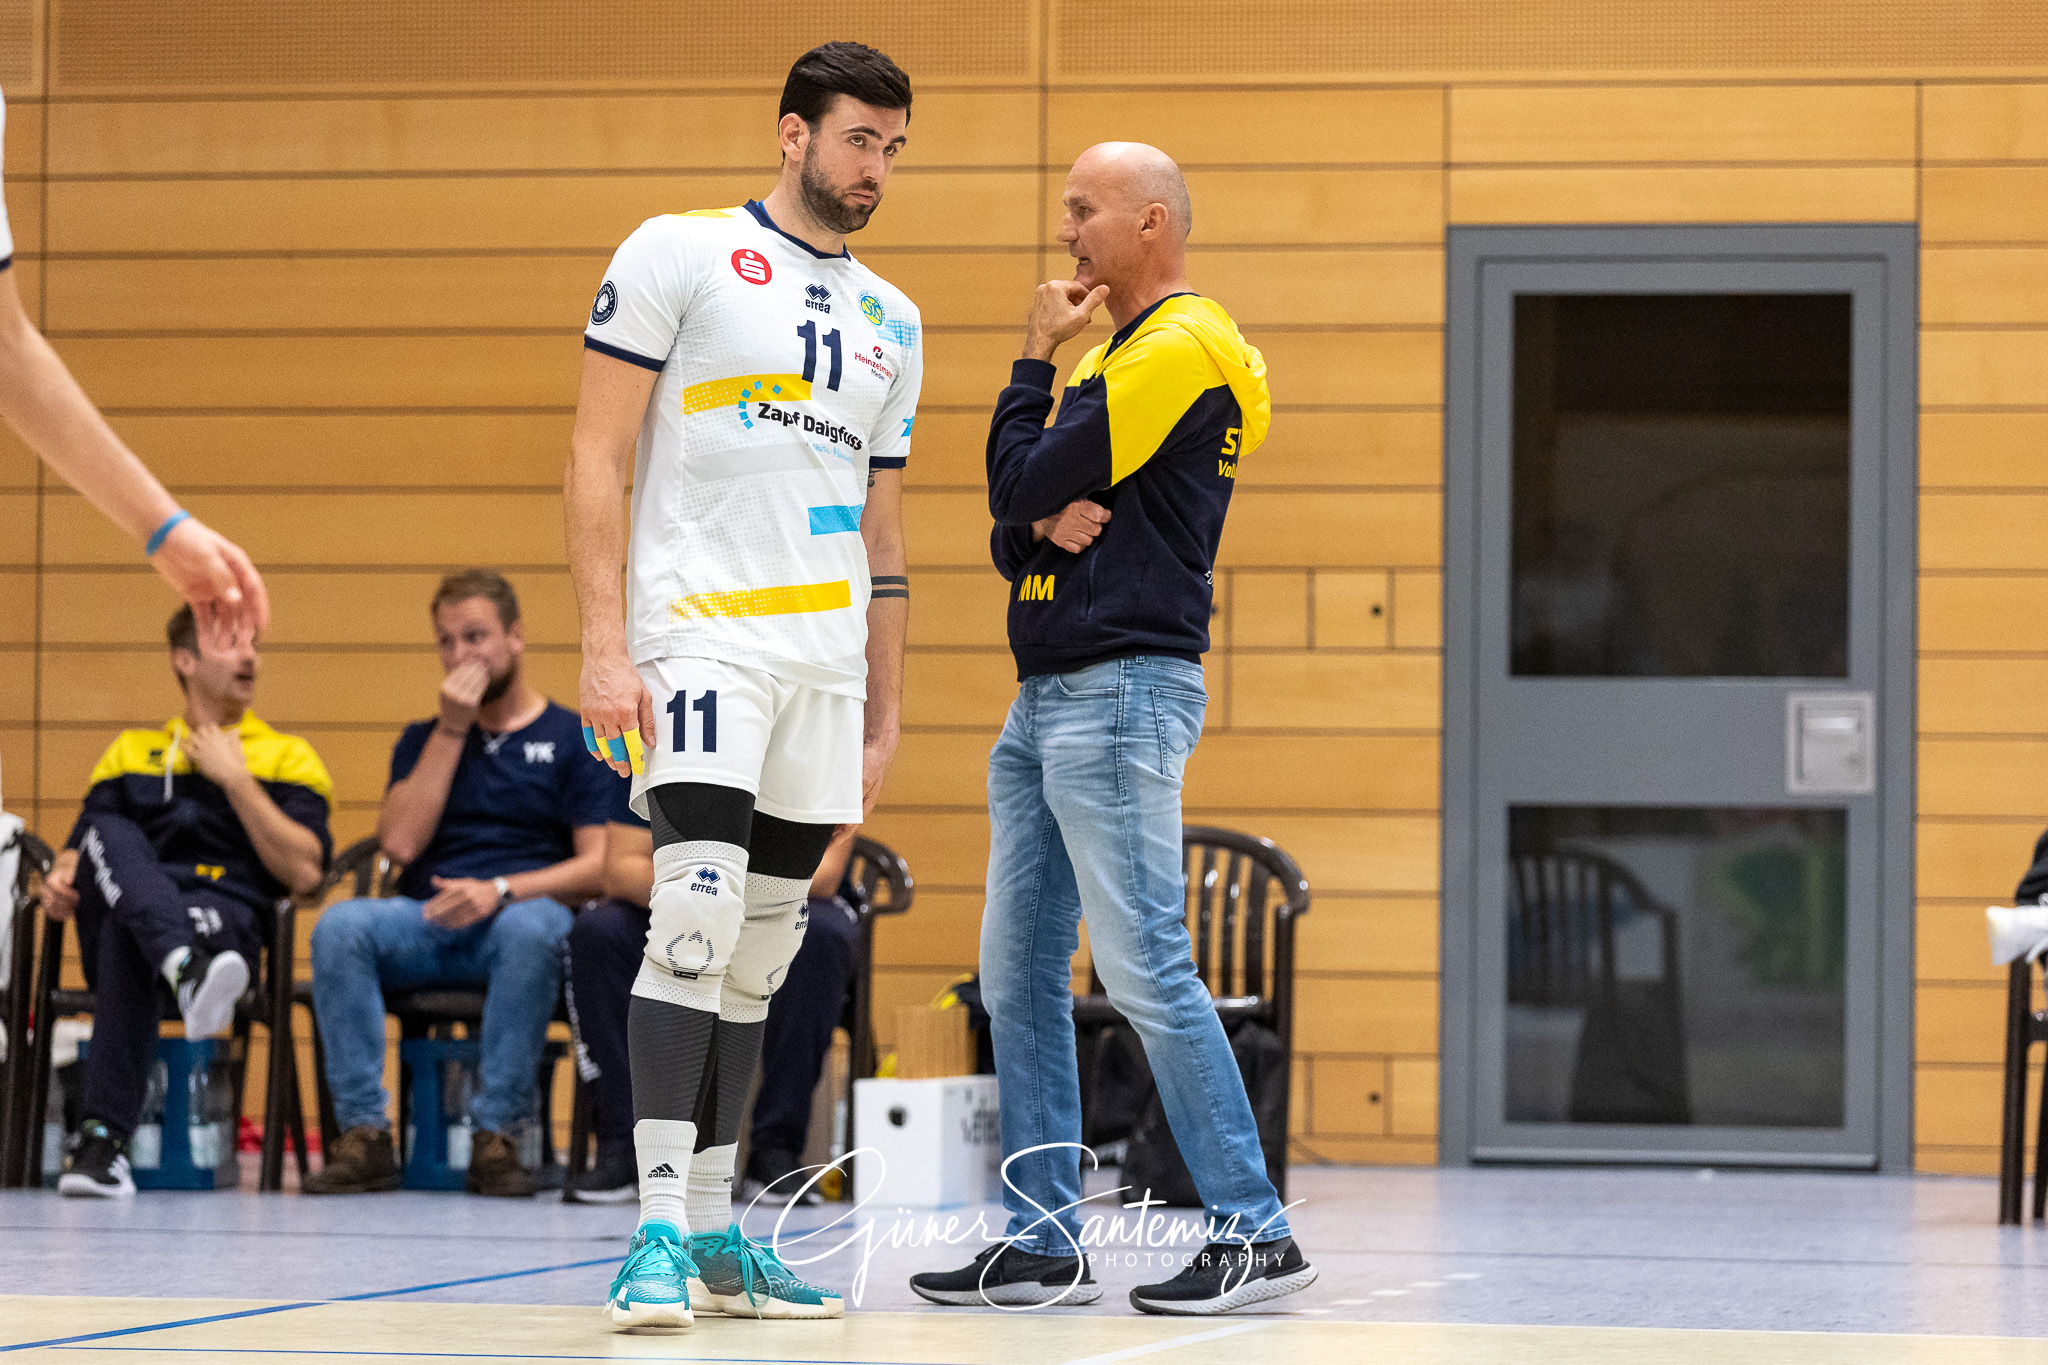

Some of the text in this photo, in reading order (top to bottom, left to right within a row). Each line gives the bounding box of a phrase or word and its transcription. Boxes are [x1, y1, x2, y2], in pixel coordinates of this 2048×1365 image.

[797, 319, 842, 392] 11
[757, 402, 863, 451] Zapf Daigfuss
[1018, 574, 1056, 602] MM
[666, 689, 717, 753] 11
[523, 741, 556, 764] YK
